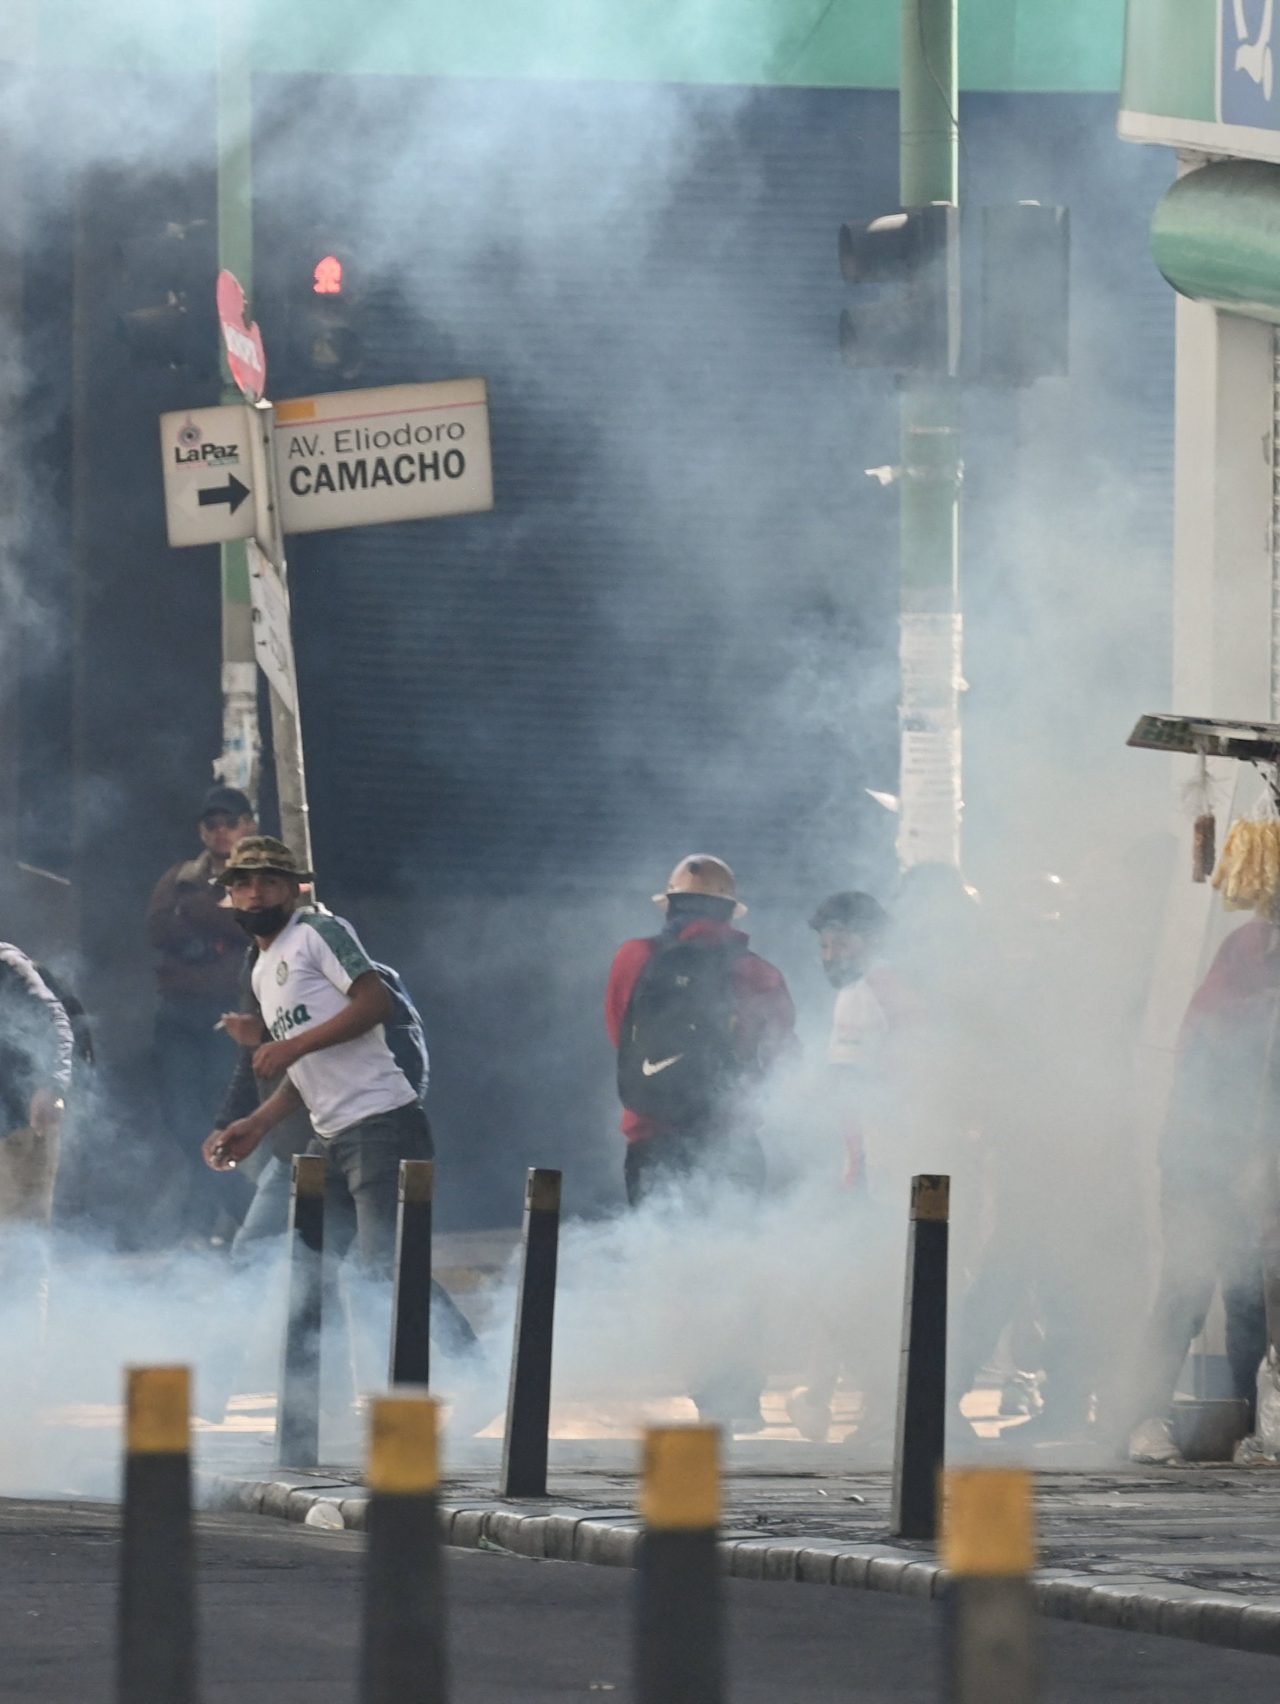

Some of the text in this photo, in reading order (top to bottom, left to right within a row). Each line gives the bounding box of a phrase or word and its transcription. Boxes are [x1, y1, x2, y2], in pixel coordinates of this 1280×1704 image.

[288, 422, 465, 459] AV. Eliodoro
[289, 448, 466, 496] CAMACHO
